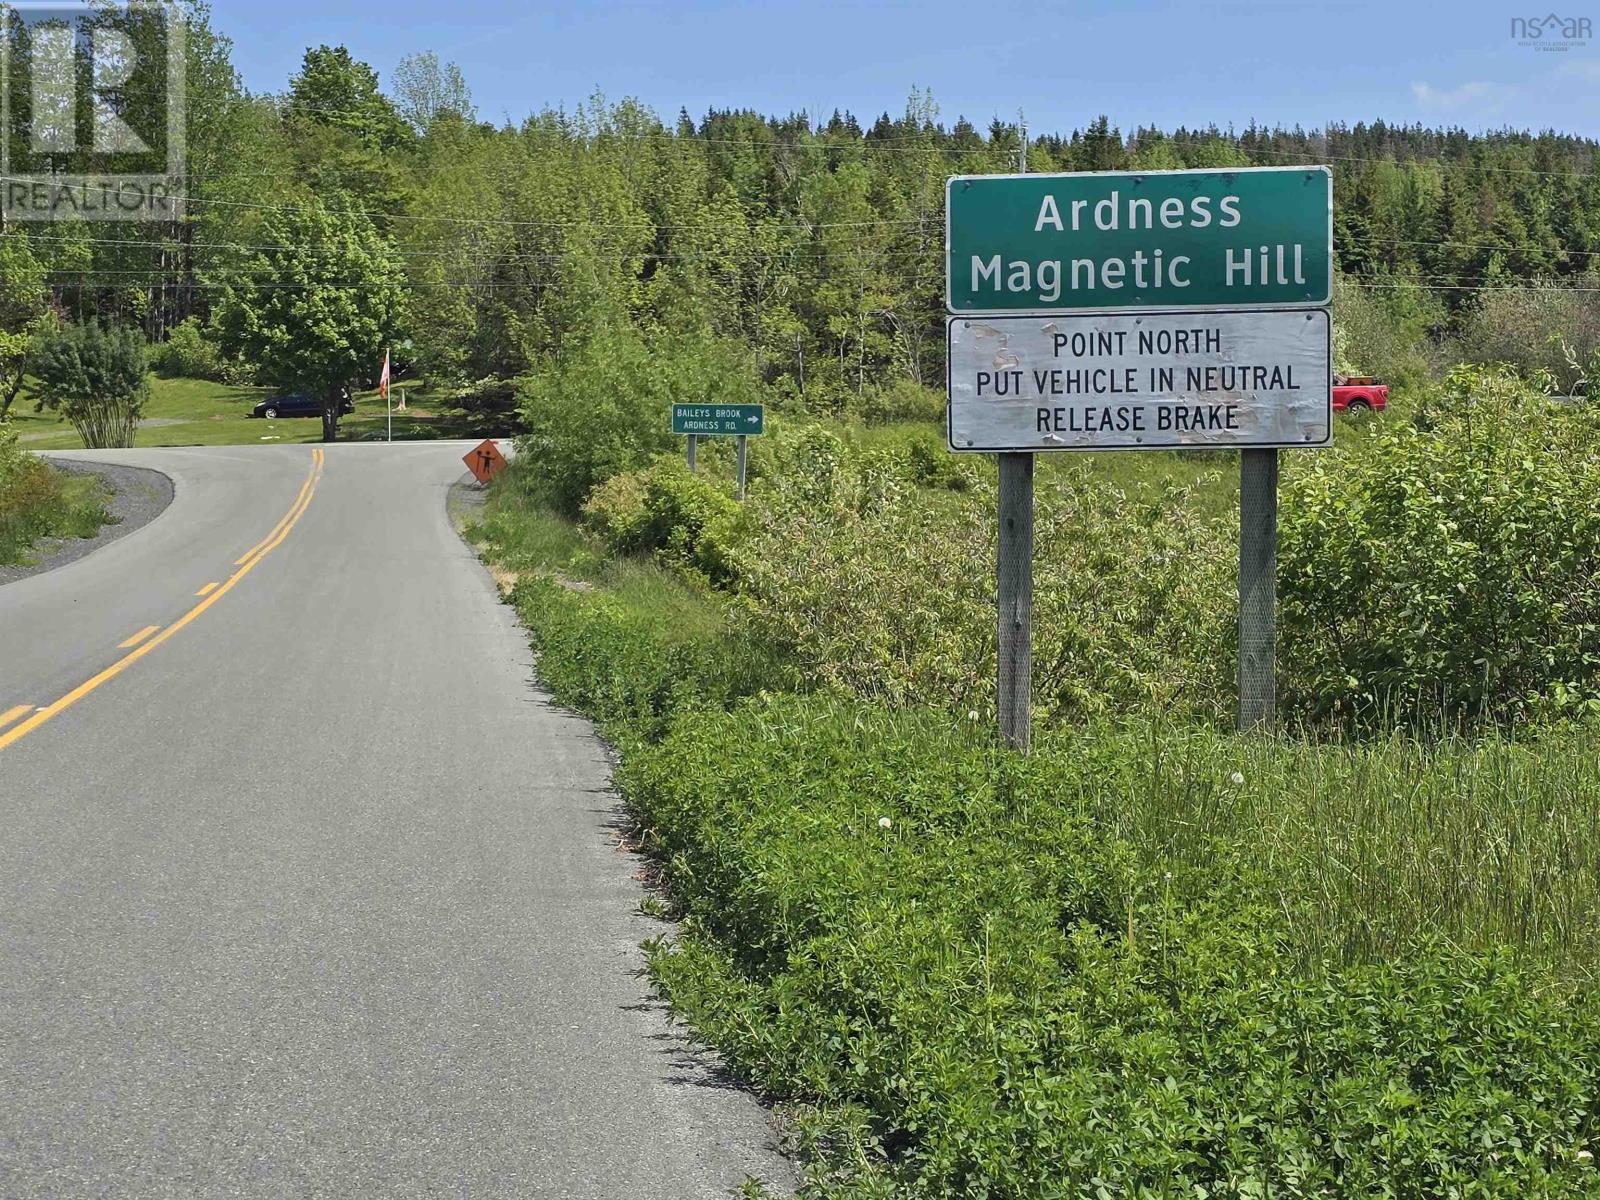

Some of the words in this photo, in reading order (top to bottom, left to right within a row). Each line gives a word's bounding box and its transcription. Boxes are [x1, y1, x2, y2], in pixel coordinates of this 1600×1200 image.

[1034, 191, 1241, 232] Ardness
[971, 248, 1191, 302] Magnetic
[1226, 244, 1306, 286] Hill
[1053, 331, 1127, 357] POINT
[1138, 328, 1221, 355] NORTH
[977, 370, 1024, 396] PUT
[1033, 368, 1138, 394] VEHICLE
[1150, 367, 1174, 392] IN
[1186, 365, 1300, 392] NEUTRAL
[677, 409, 710, 417] BAILEYS
[715, 409, 741, 418] BROOK
[683, 421, 719, 430] ARDNESS
[1037, 406, 1145, 432] RELEASE
[1157, 405, 1239, 431] BRAKE
